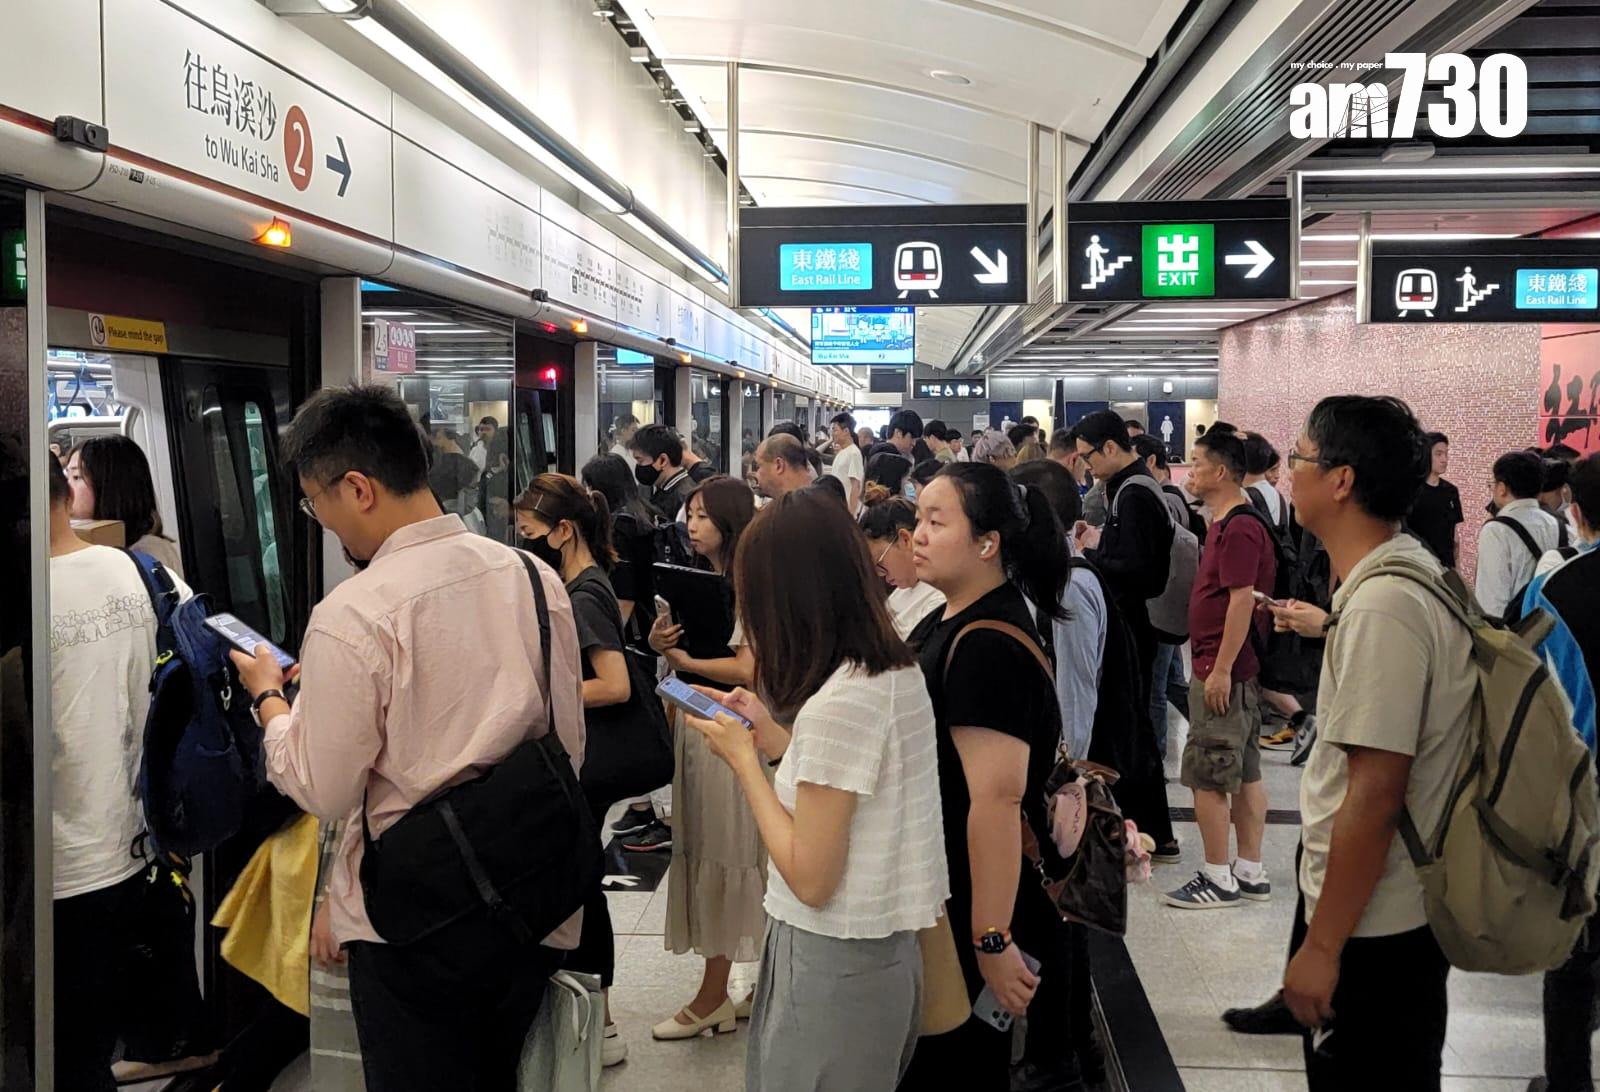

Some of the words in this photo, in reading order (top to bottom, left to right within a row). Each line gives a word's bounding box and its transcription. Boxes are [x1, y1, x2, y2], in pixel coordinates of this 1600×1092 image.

[183, 48, 277, 141] 往烏溪沙
[205, 134, 217, 159] to
[220, 137, 238, 166] Wu
[241, 146, 258, 176] Kai
[260, 154, 279, 182] Sha
[292, 121, 306, 177] 2
[791, 248, 860, 272] 東鐵綫
[791, 274, 814, 285] East
[816, 274, 835, 285] Rail
[837, 274, 861, 285] Line
[1157, 272, 1199, 286] EXIT
[1527, 273, 1588, 293] 東鐵綫
[1526, 295, 1545, 305] East
[1548, 295, 1565, 305] Rail
[1566, 295, 1587, 305] Line
[108, 326, 128, 339] Please
[128, 328, 143, 341] mind
[143, 330, 153, 342] the
[153, 333, 163, 345] gap
